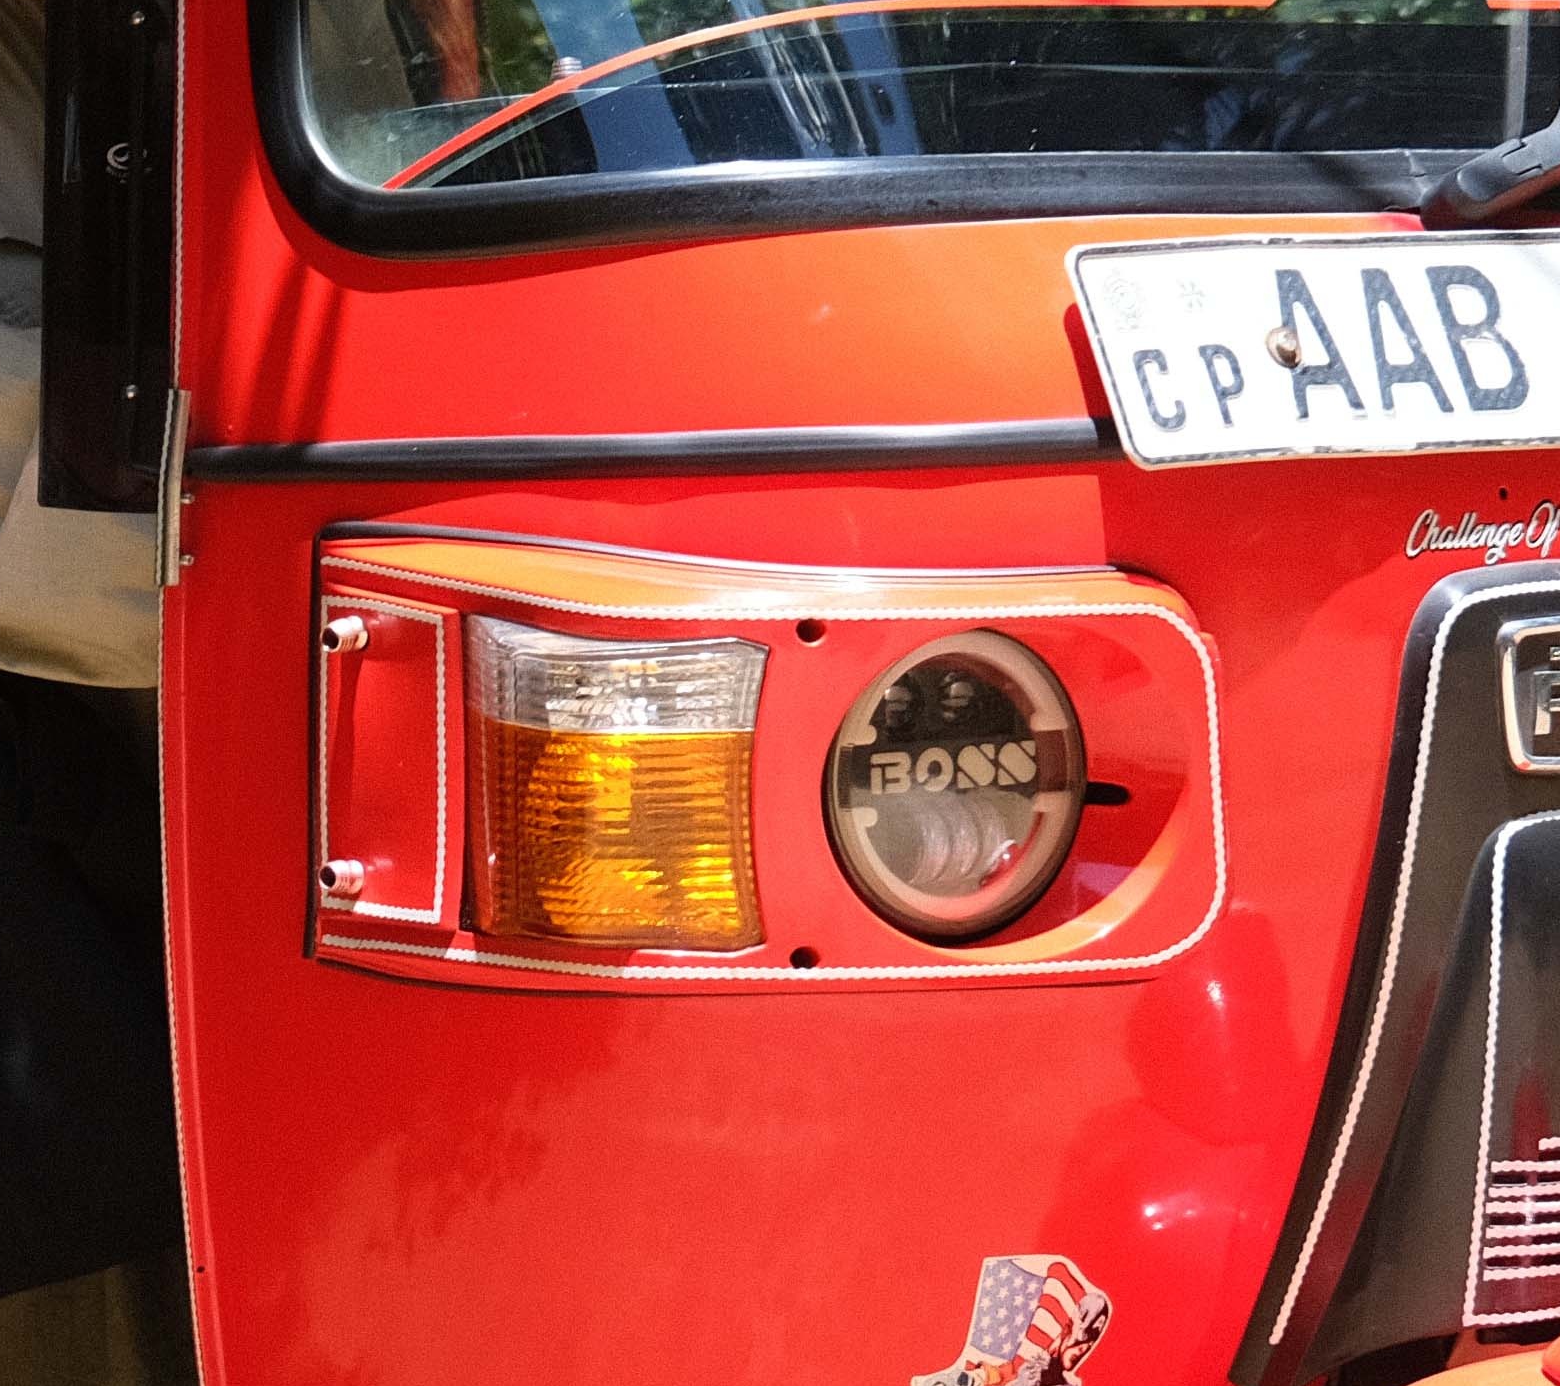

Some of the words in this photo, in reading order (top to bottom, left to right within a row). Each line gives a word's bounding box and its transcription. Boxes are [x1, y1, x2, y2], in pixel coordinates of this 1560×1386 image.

[1132, 342, 1247, 434] CP
[1274, 265, 1530, 420] AAB
[1405, 508, 1525, 564] Challenge
[870, 740, 1037, 795] BOSS
